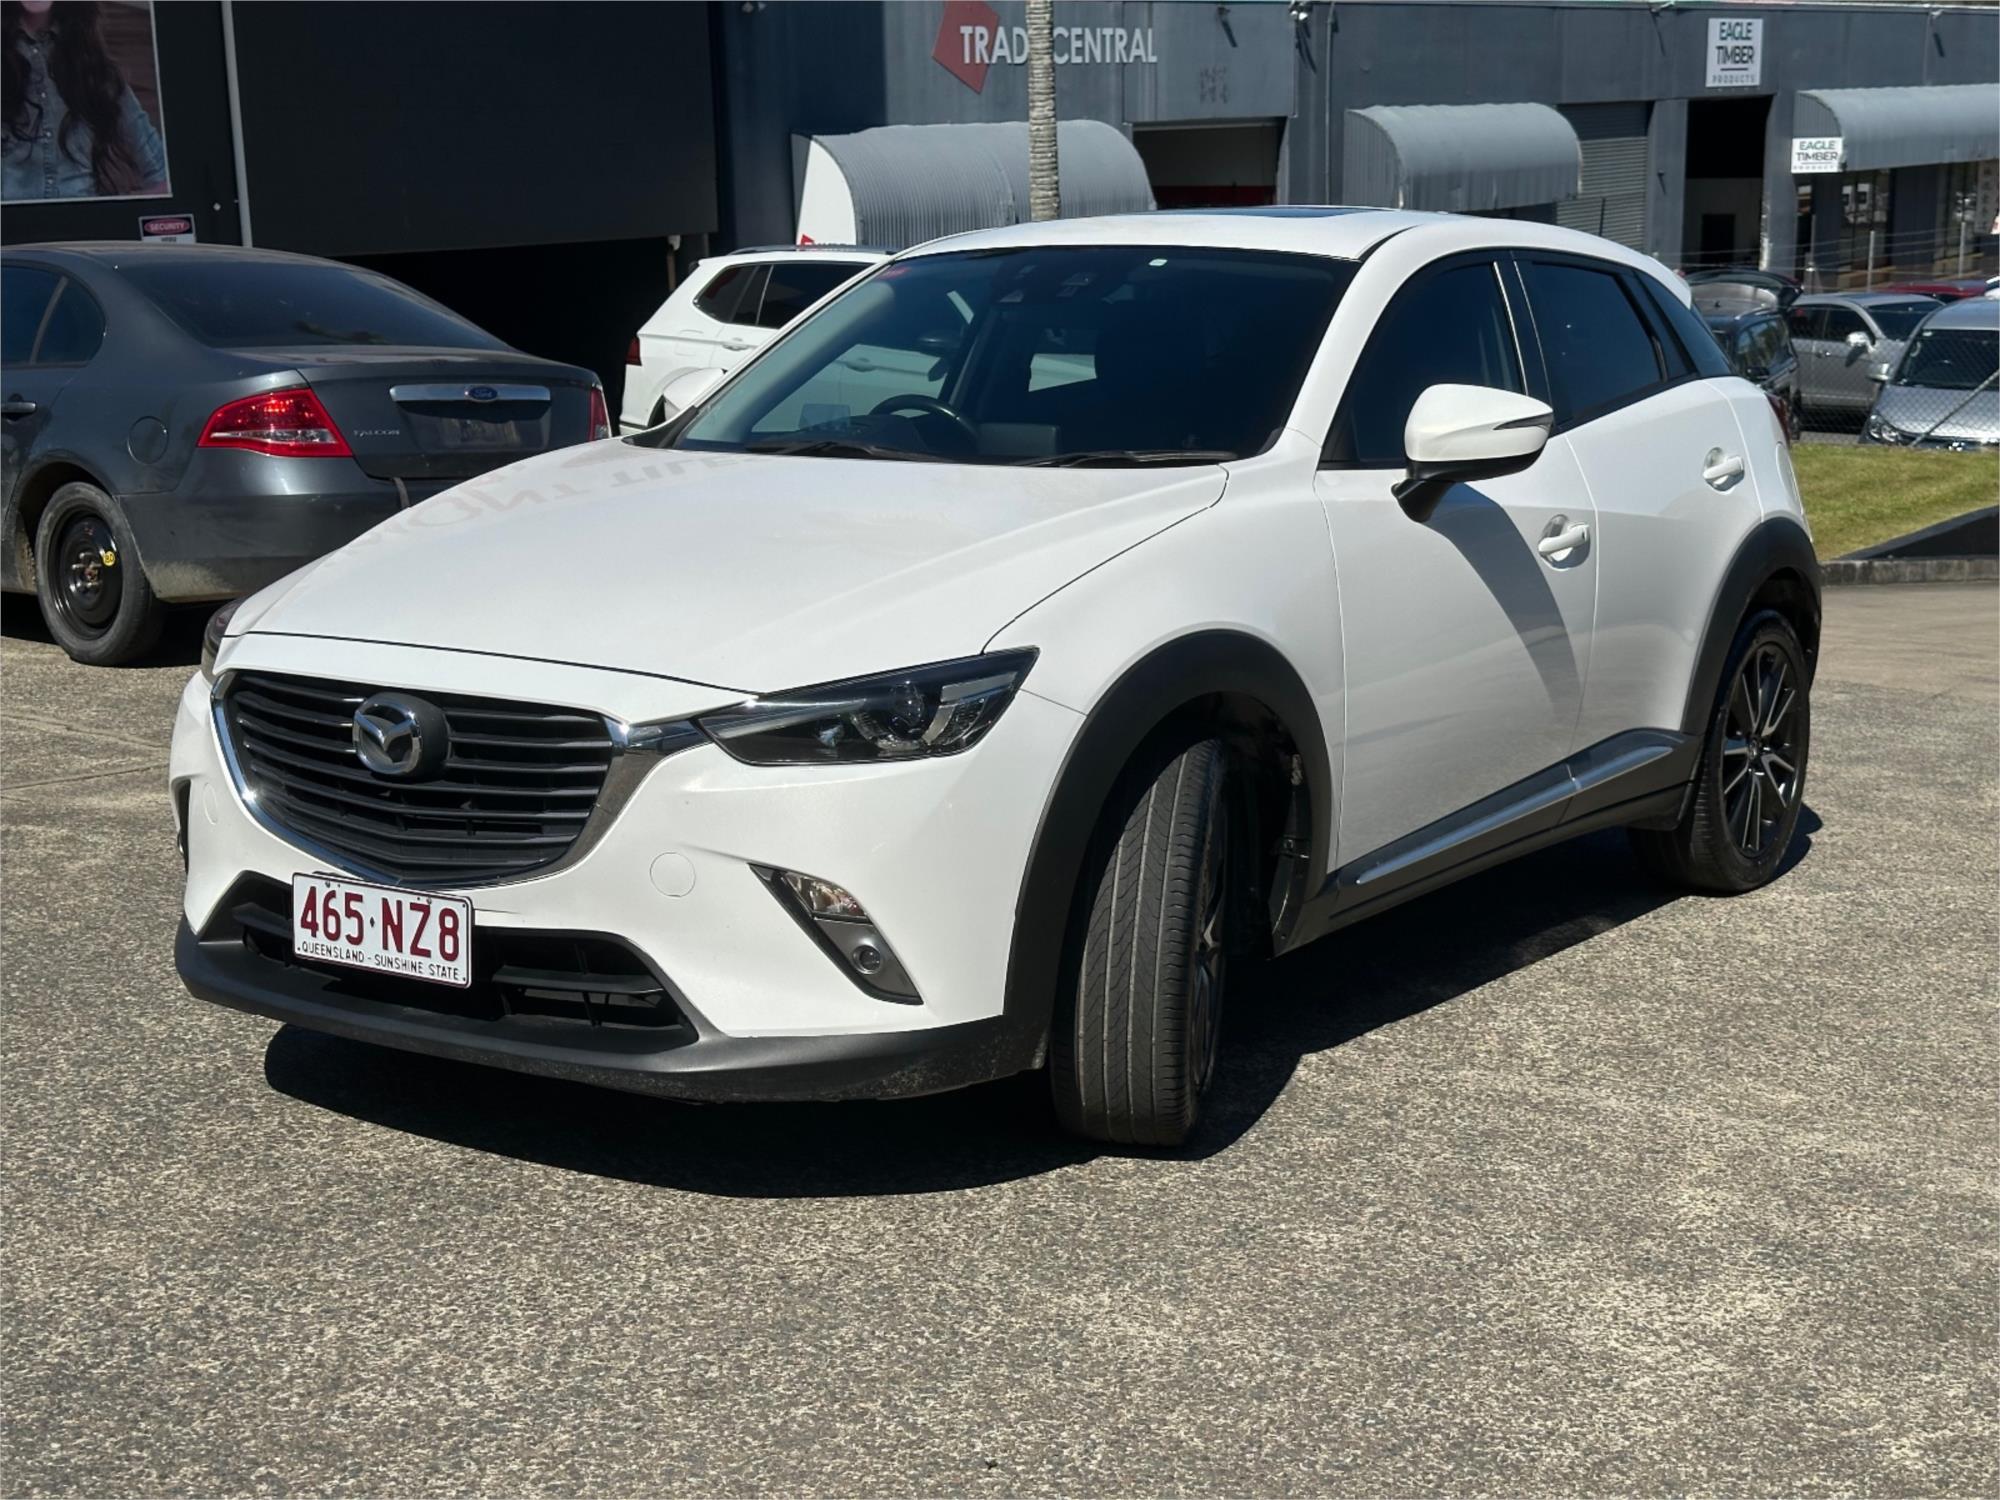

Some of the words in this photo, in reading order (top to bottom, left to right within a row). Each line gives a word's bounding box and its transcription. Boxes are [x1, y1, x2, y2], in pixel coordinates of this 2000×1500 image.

[1719, 21, 1753, 41] EAGLE
[959, 25, 1031, 65] TRAD
[1053, 26, 1158, 64] CENTRAL
[1716, 45, 1755, 65] TIMBER
[1799, 140, 1836, 151] EAGLE
[1796, 151, 1839, 161] TIMBER
[302, 940, 365, 962] QUEENSLAND
[374, 955, 424, 975] SUNSHINE
[428, 963, 460, 980] STATE
